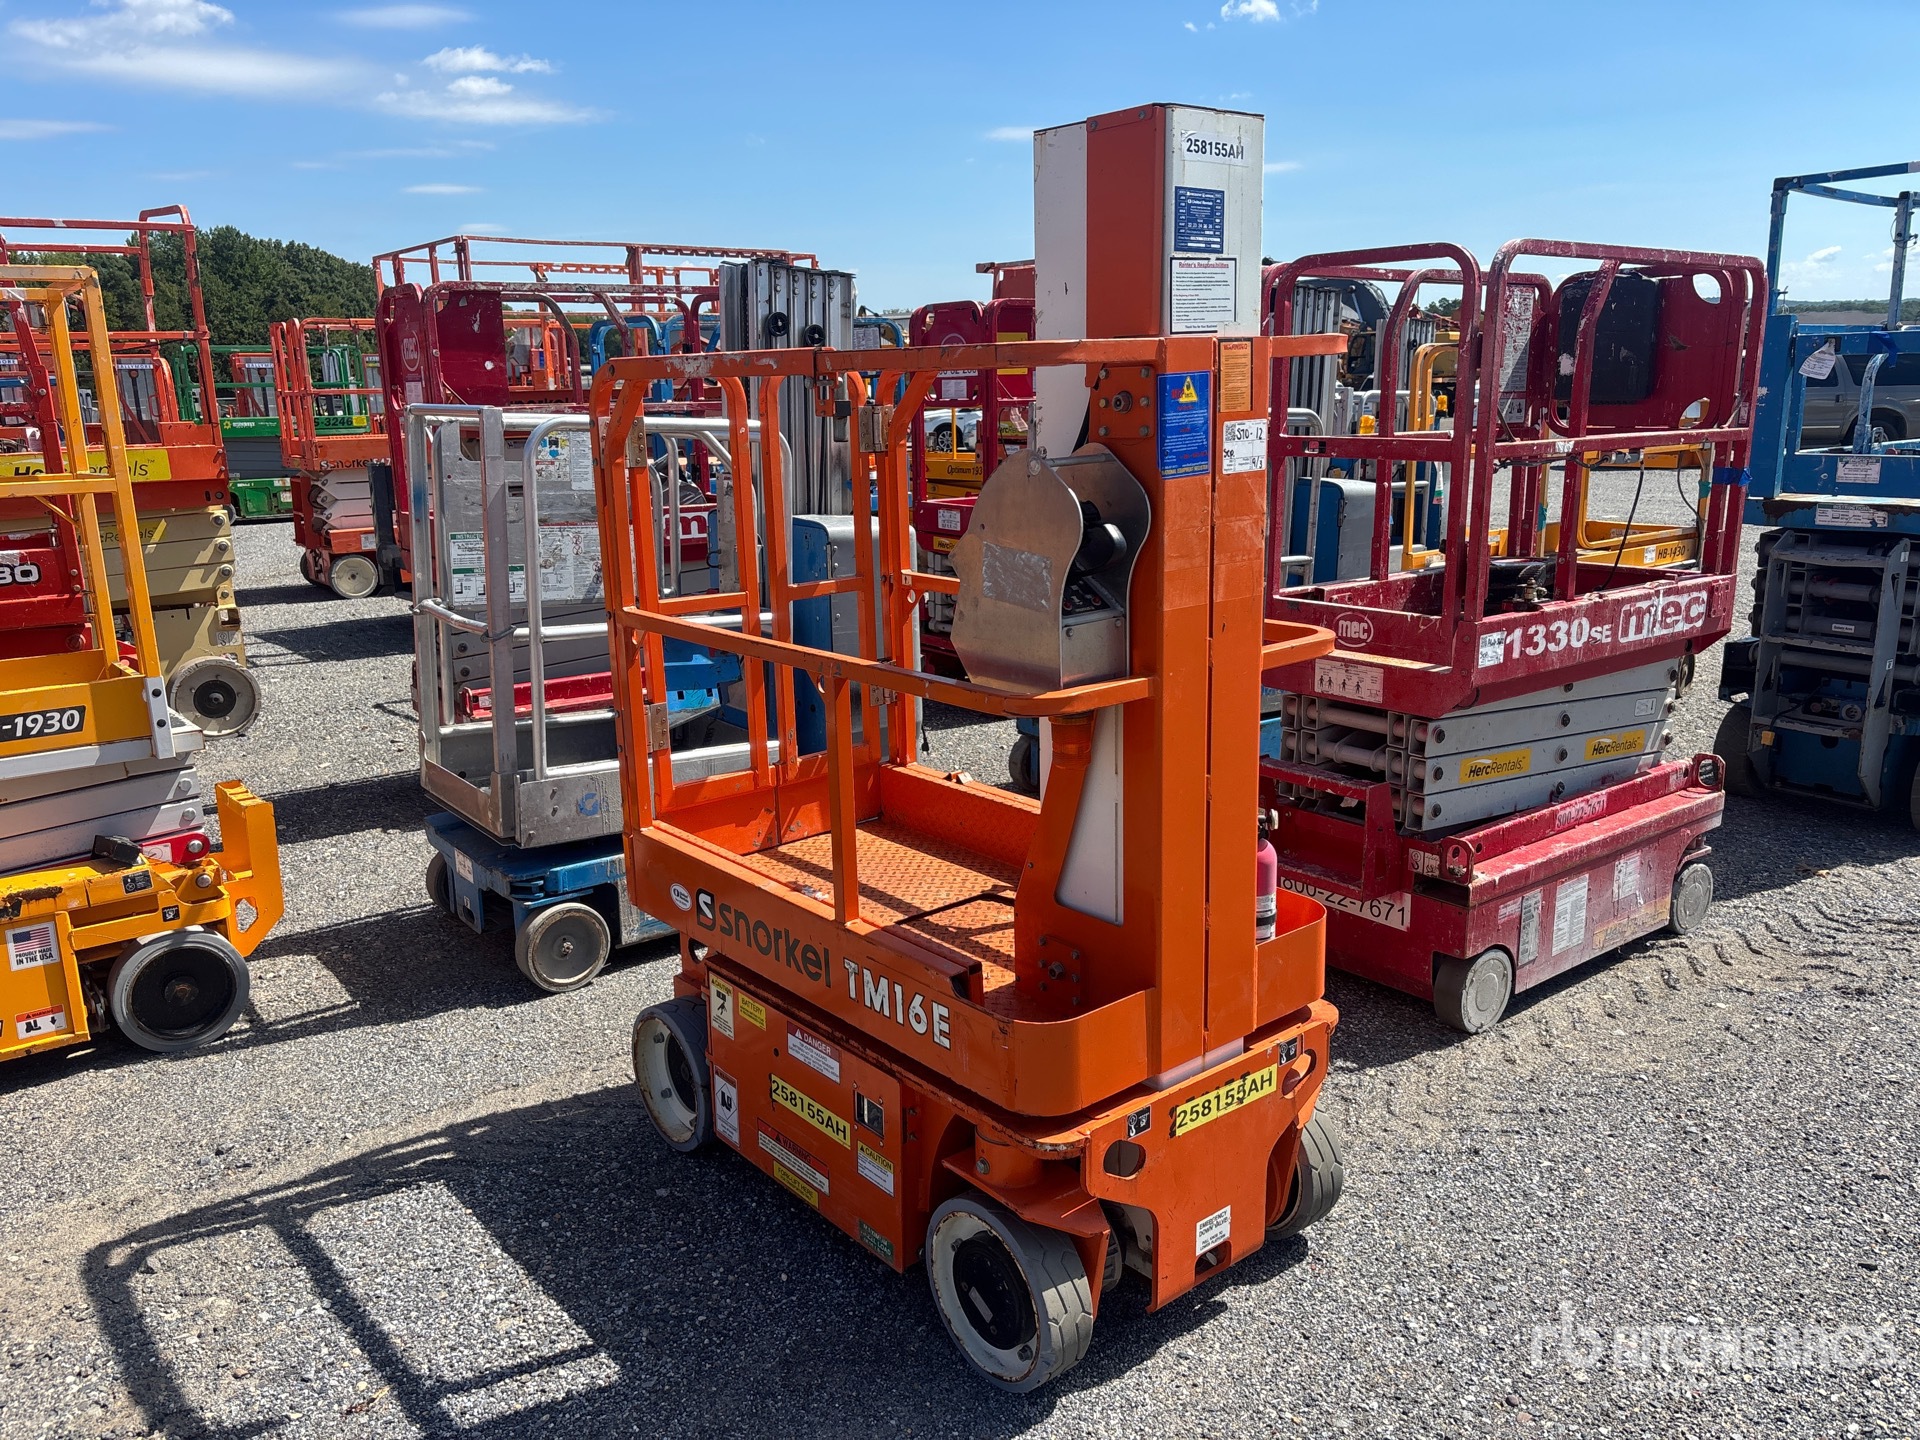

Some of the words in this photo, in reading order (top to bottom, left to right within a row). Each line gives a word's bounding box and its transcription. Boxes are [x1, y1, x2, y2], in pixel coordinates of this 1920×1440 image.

[1186, 137, 1244, 160] 258155AH
[947, 465, 971, 475] Optimum
[1622, 594, 1706, 641] mec
[1338, 619, 1368, 640] mec
[15, 950, 37, 959] PROUDLY
[719, 902, 832, 989] snorkel
[16, 958, 25, 966] IN
[25, 955, 38, 964] THE
[39, 952, 54, 960] USA
[741, 997, 763, 1015] BATTERY
[843, 955, 951, 1051] TM16E
[803, 1032, 831, 1055] DANGER
[772, 1079, 848, 1141] 258155AH
[1177, 1070, 1274, 1130] 258155AH
[782, 1137, 812, 1163] WARNING
[865, 1147, 892, 1171] CAUTION
[1199, 1210, 1228, 1230] EMERGENCY
[1199, 1224, 1214, 1237] DOWN
